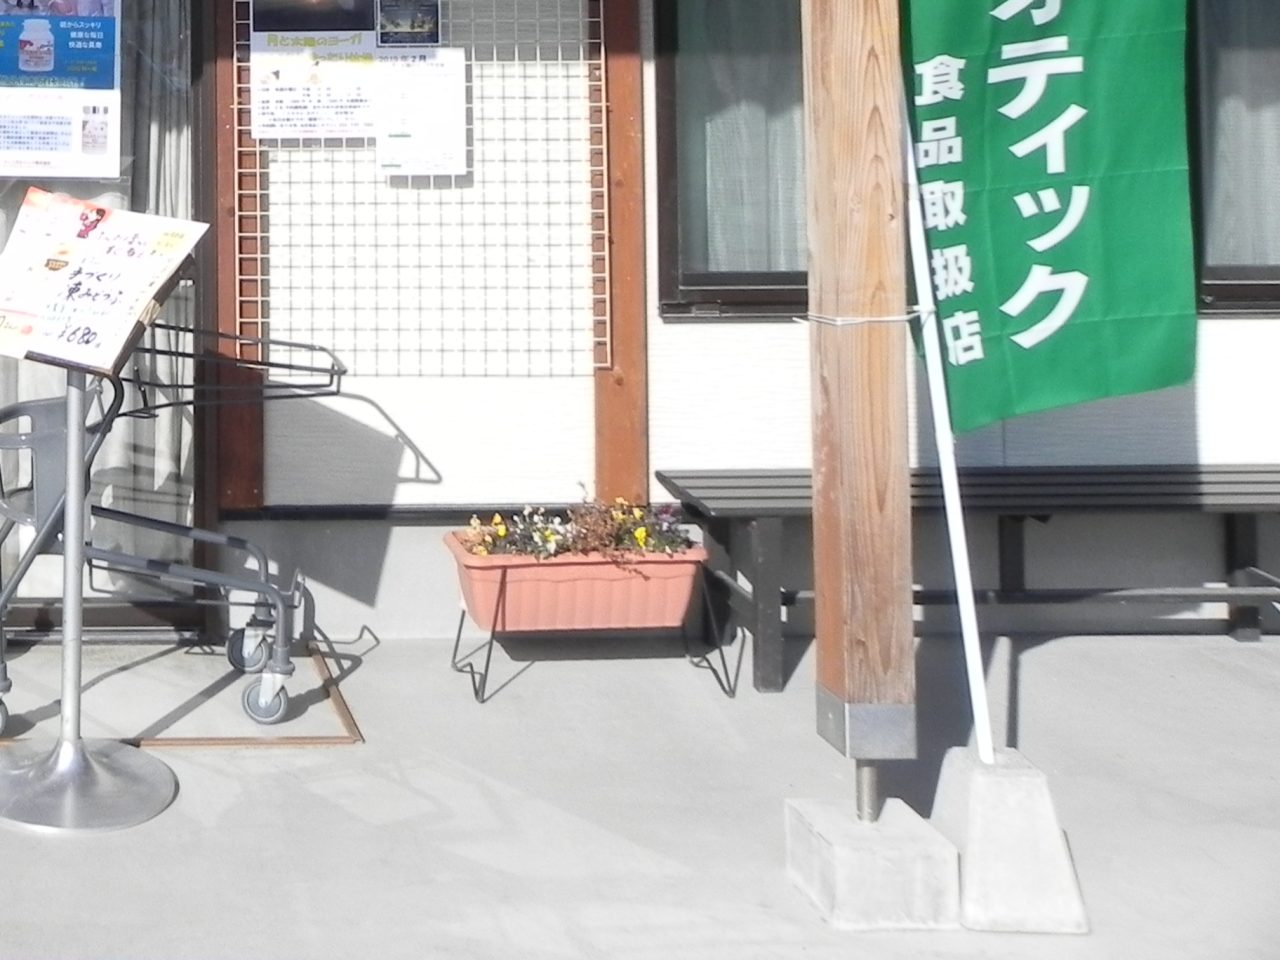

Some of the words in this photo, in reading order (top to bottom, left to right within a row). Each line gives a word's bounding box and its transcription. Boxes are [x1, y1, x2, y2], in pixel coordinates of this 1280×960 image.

[913, 53, 985, 367] 食品取扱店
